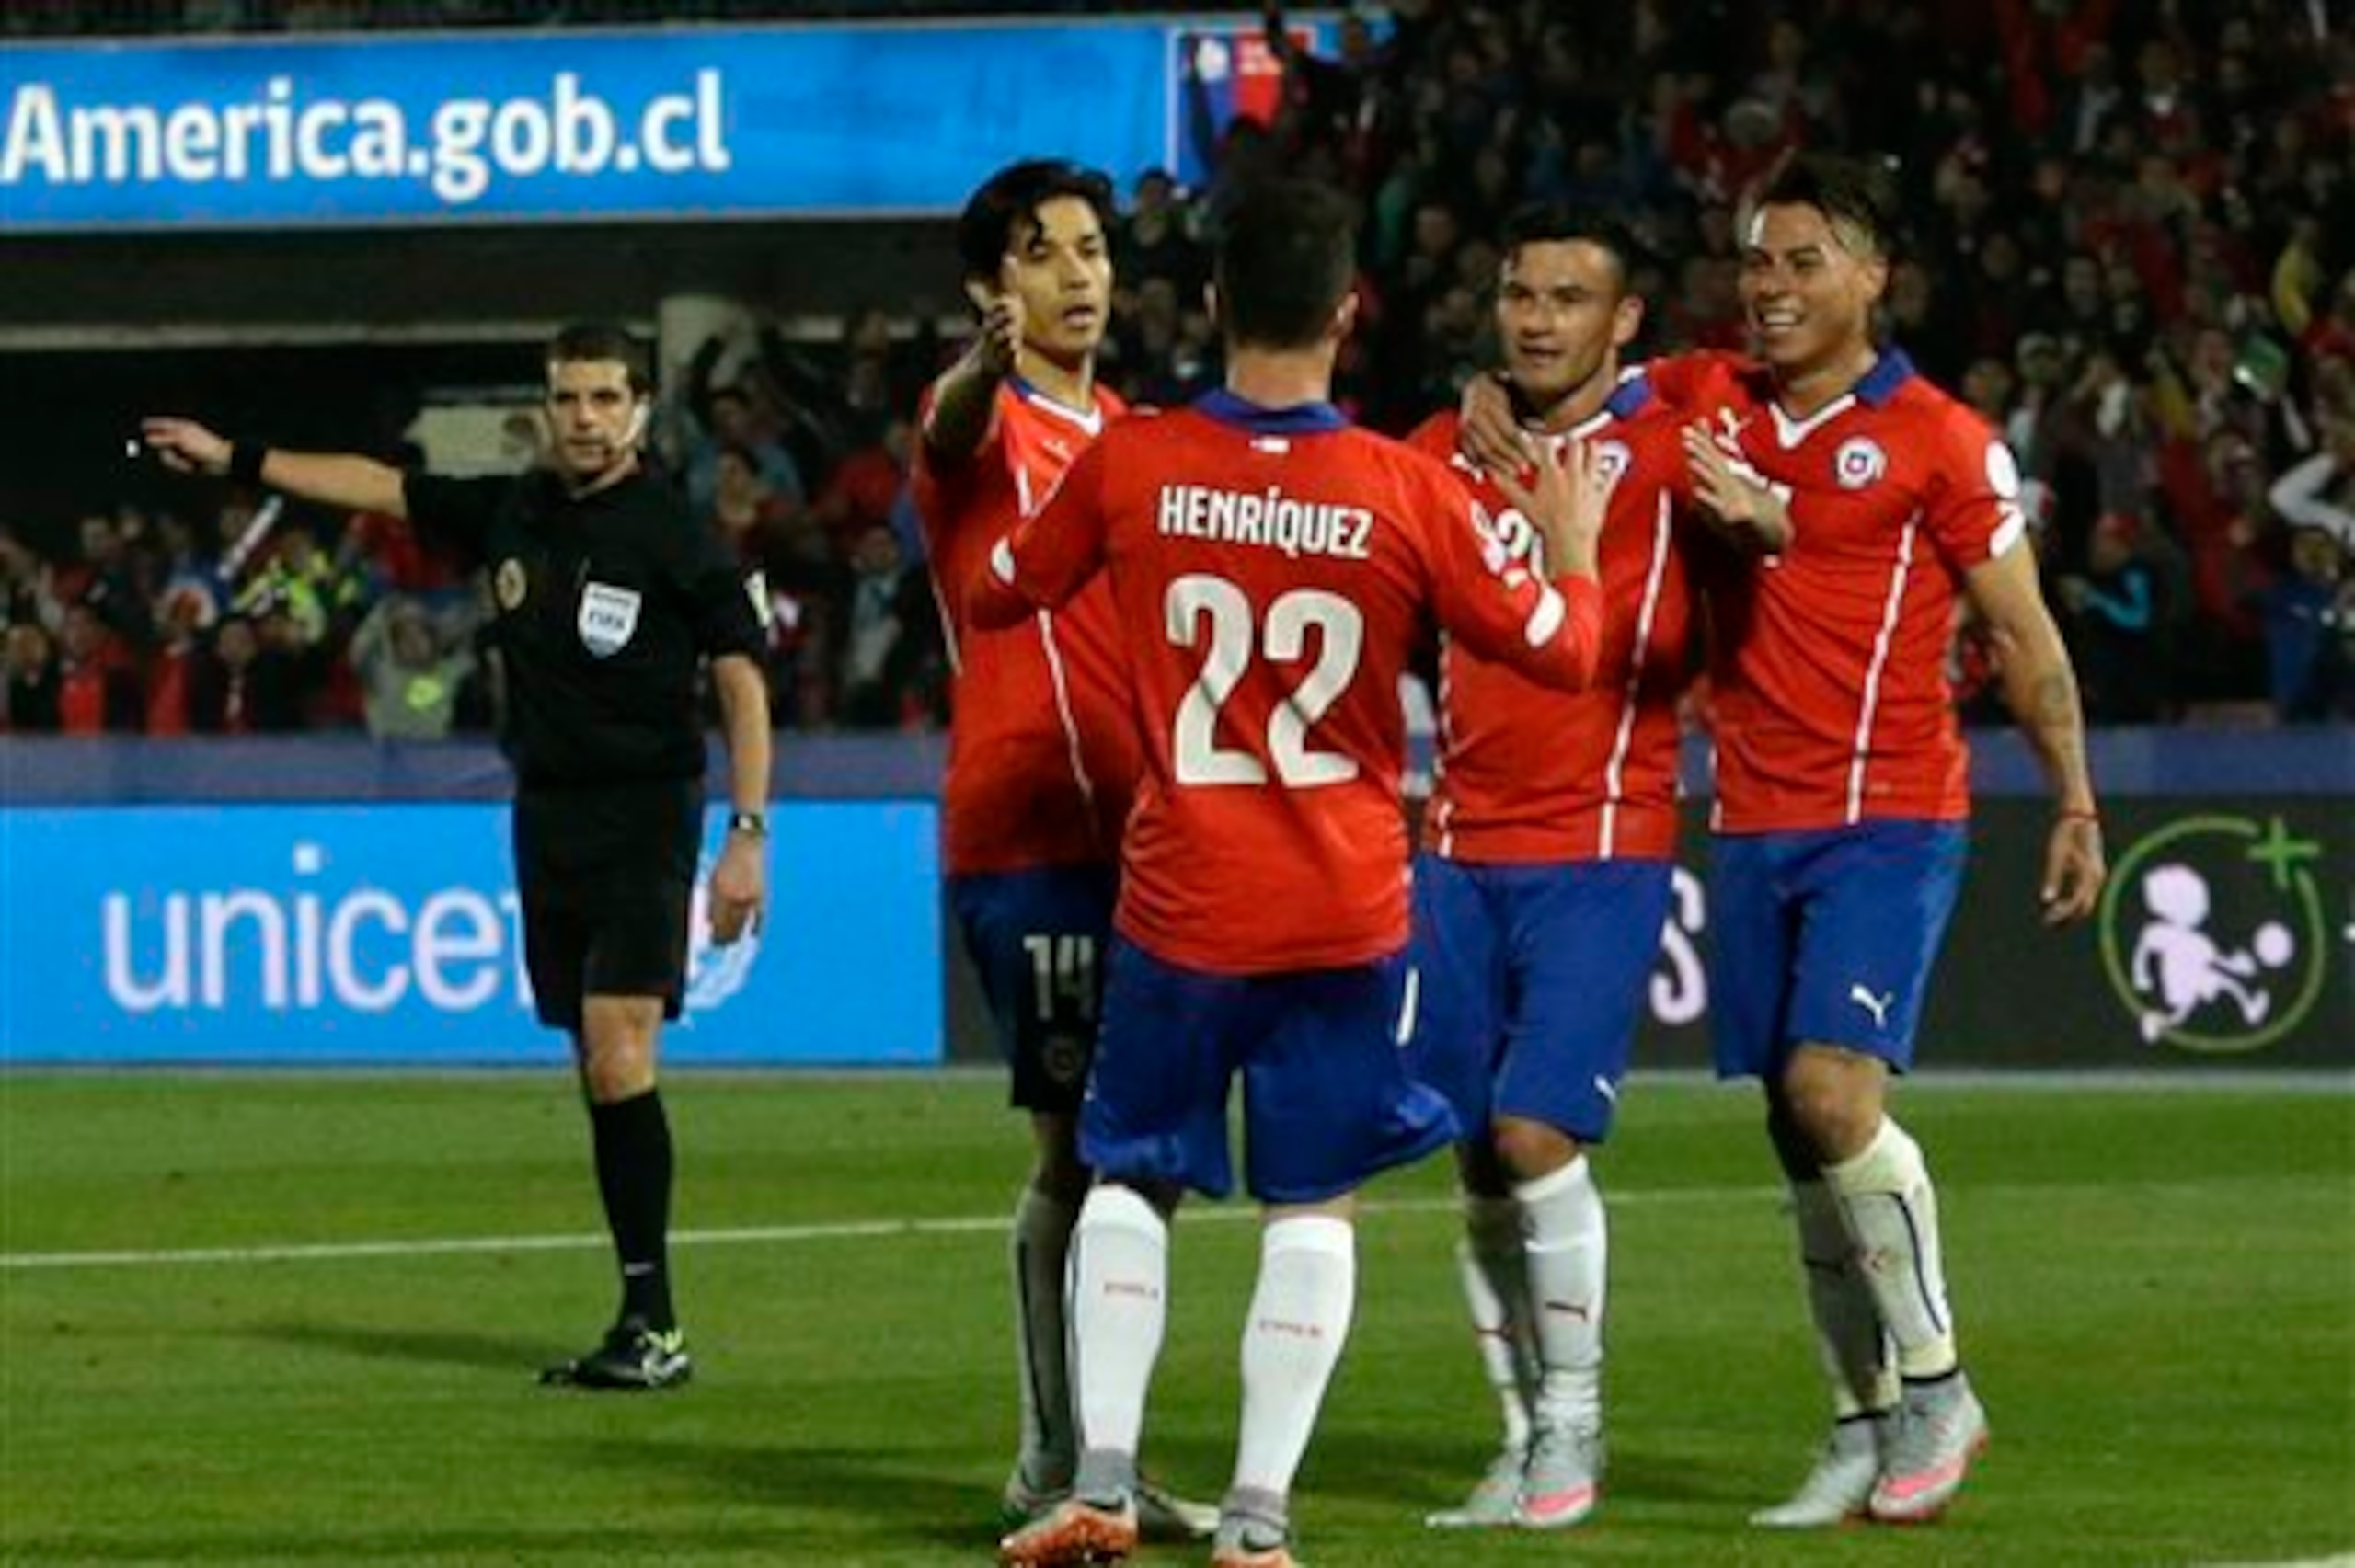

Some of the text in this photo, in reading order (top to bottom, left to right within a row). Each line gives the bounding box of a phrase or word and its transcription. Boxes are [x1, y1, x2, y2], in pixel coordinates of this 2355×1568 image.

[2, 68, 731, 202] America.gob.cl
[1157, 485, 1373, 559] HENRÍQUEZ
[1165, 573, 1364, 788] 22
[1023, 934, 1096, 1022] 14
